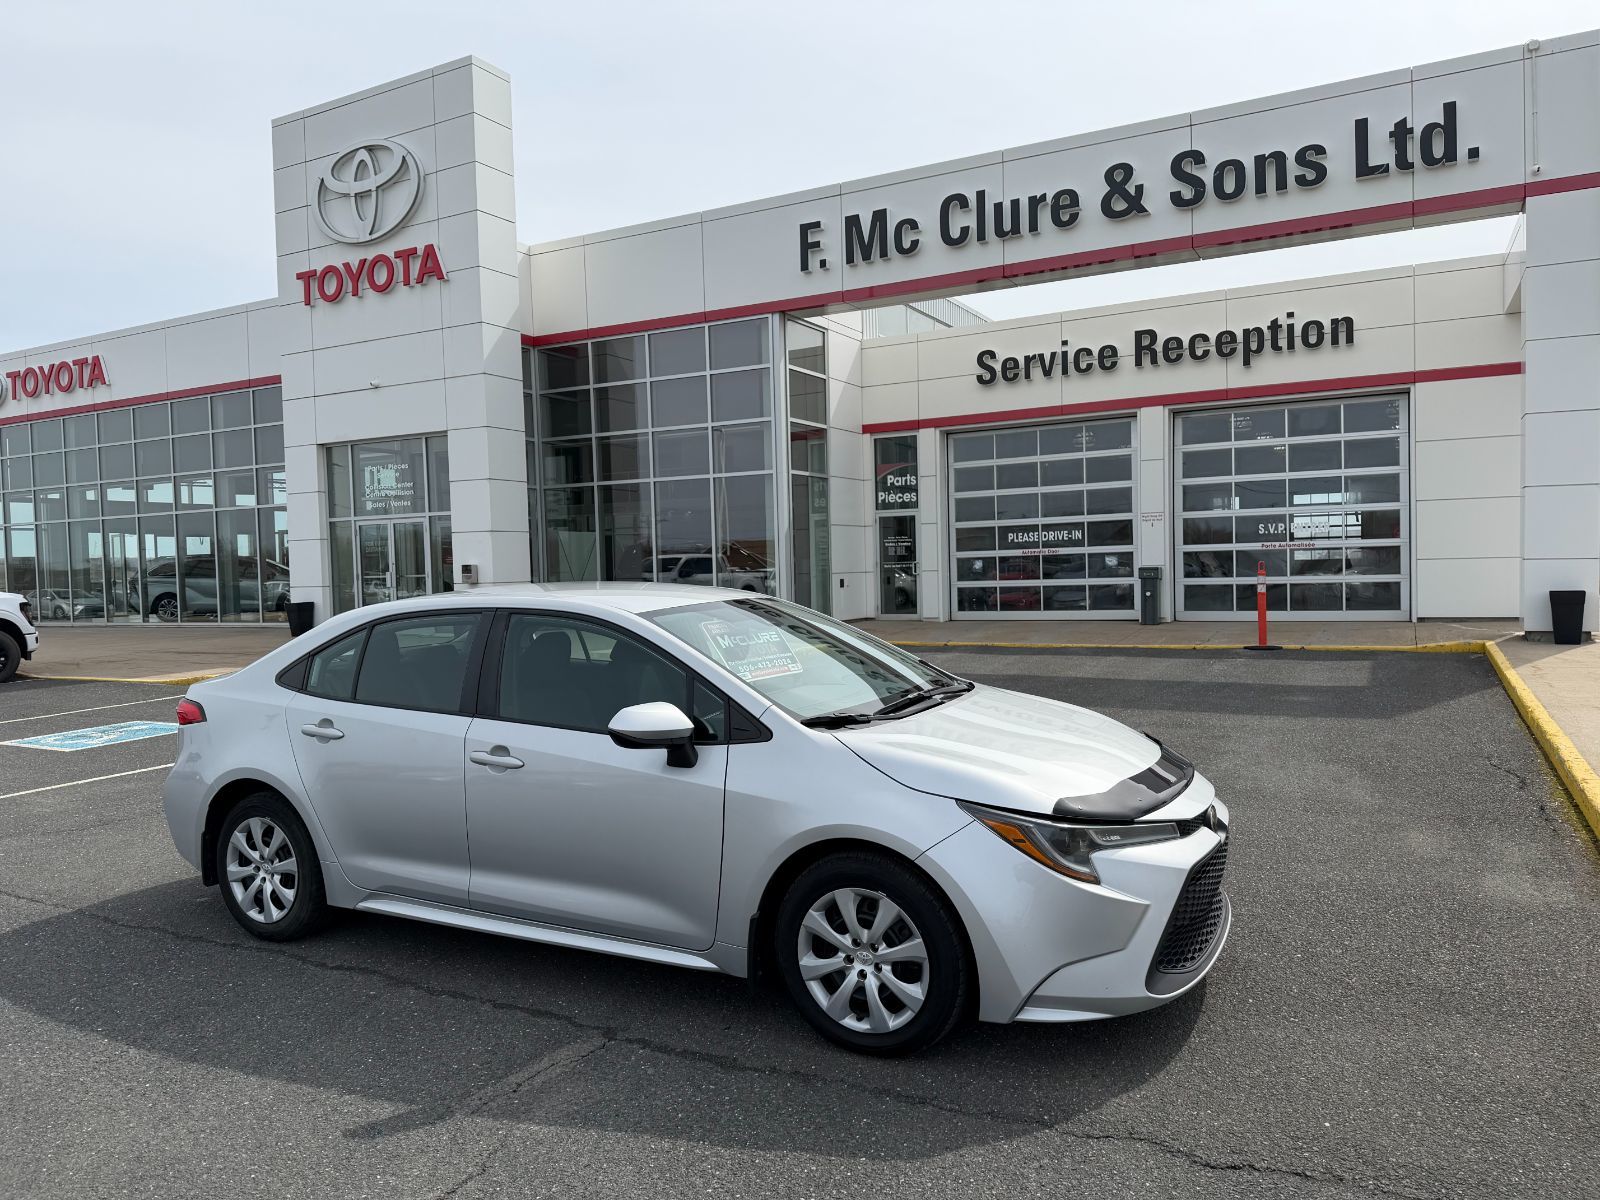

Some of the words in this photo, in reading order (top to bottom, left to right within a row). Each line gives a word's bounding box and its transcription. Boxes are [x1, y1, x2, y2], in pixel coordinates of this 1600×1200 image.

[798, 221, 830, 273] F.
[845, 208, 921, 265] Mc
[939, 188, 1082, 248] Clure
[1100, 162, 1152, 220] &
[1169, 143, 1328, 210] Sons
[1354, 100, 1480, 181] Ltd.
[295, 243, 448, 306] TOYOTA
[975, 339, 1119, 386] Service
[1133, 311, 1355, 368] Reception
[5, 354, 109, 401] TOYOTA
[887, 473, 917, 487] Parts
[878, 489, 917, 504] Pièces
[1008, 531, 1039, 543] PLEASE
[1042, 529, 1082, 541] DRIVE-IN
[1258, 522, 1286, 535] S.V.P.
